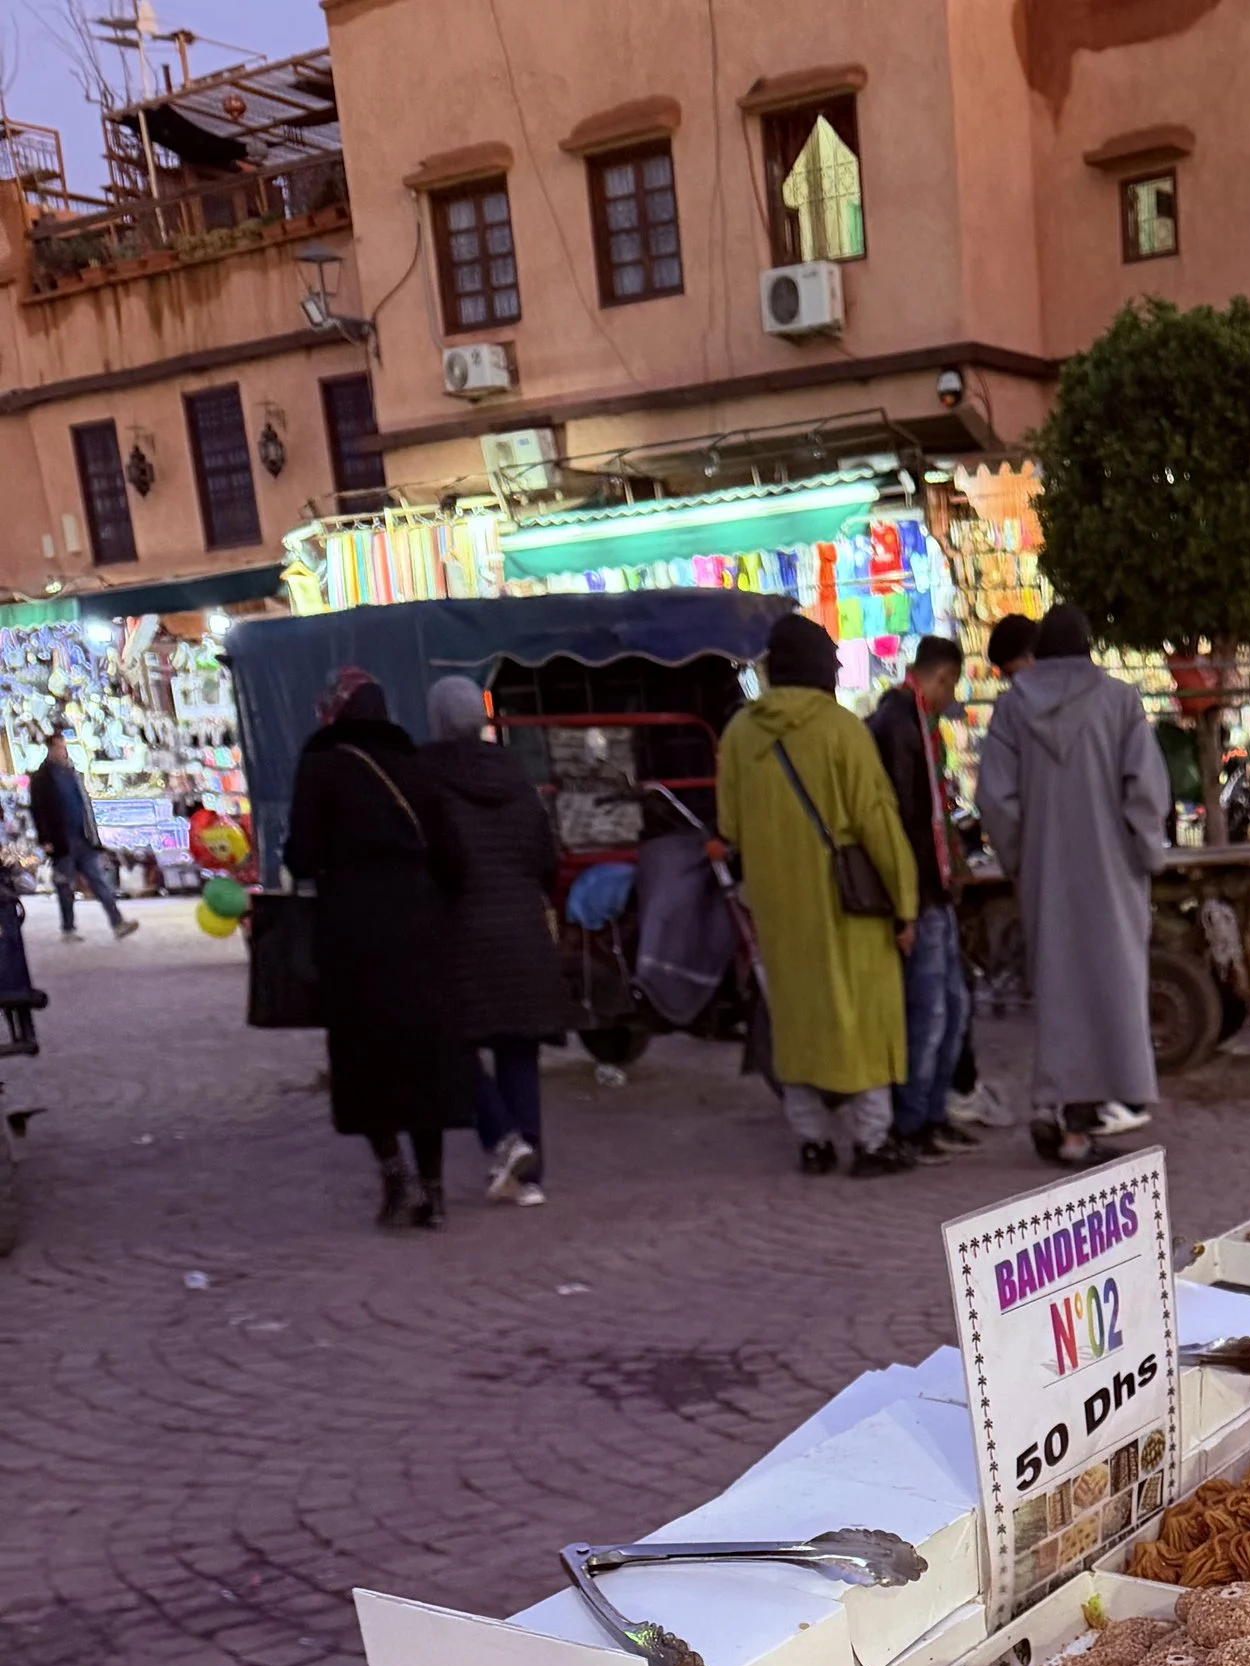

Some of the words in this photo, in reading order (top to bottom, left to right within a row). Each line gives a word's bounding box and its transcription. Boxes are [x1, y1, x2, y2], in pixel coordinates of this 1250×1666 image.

[994, 1190, 1139, 1311] BANDERAS
[1049, 1277, 1124, 1376] N°02
[1016, 1422, 1069, 1491] 50
[1083, 1353, 1158, 1437] Dhs
